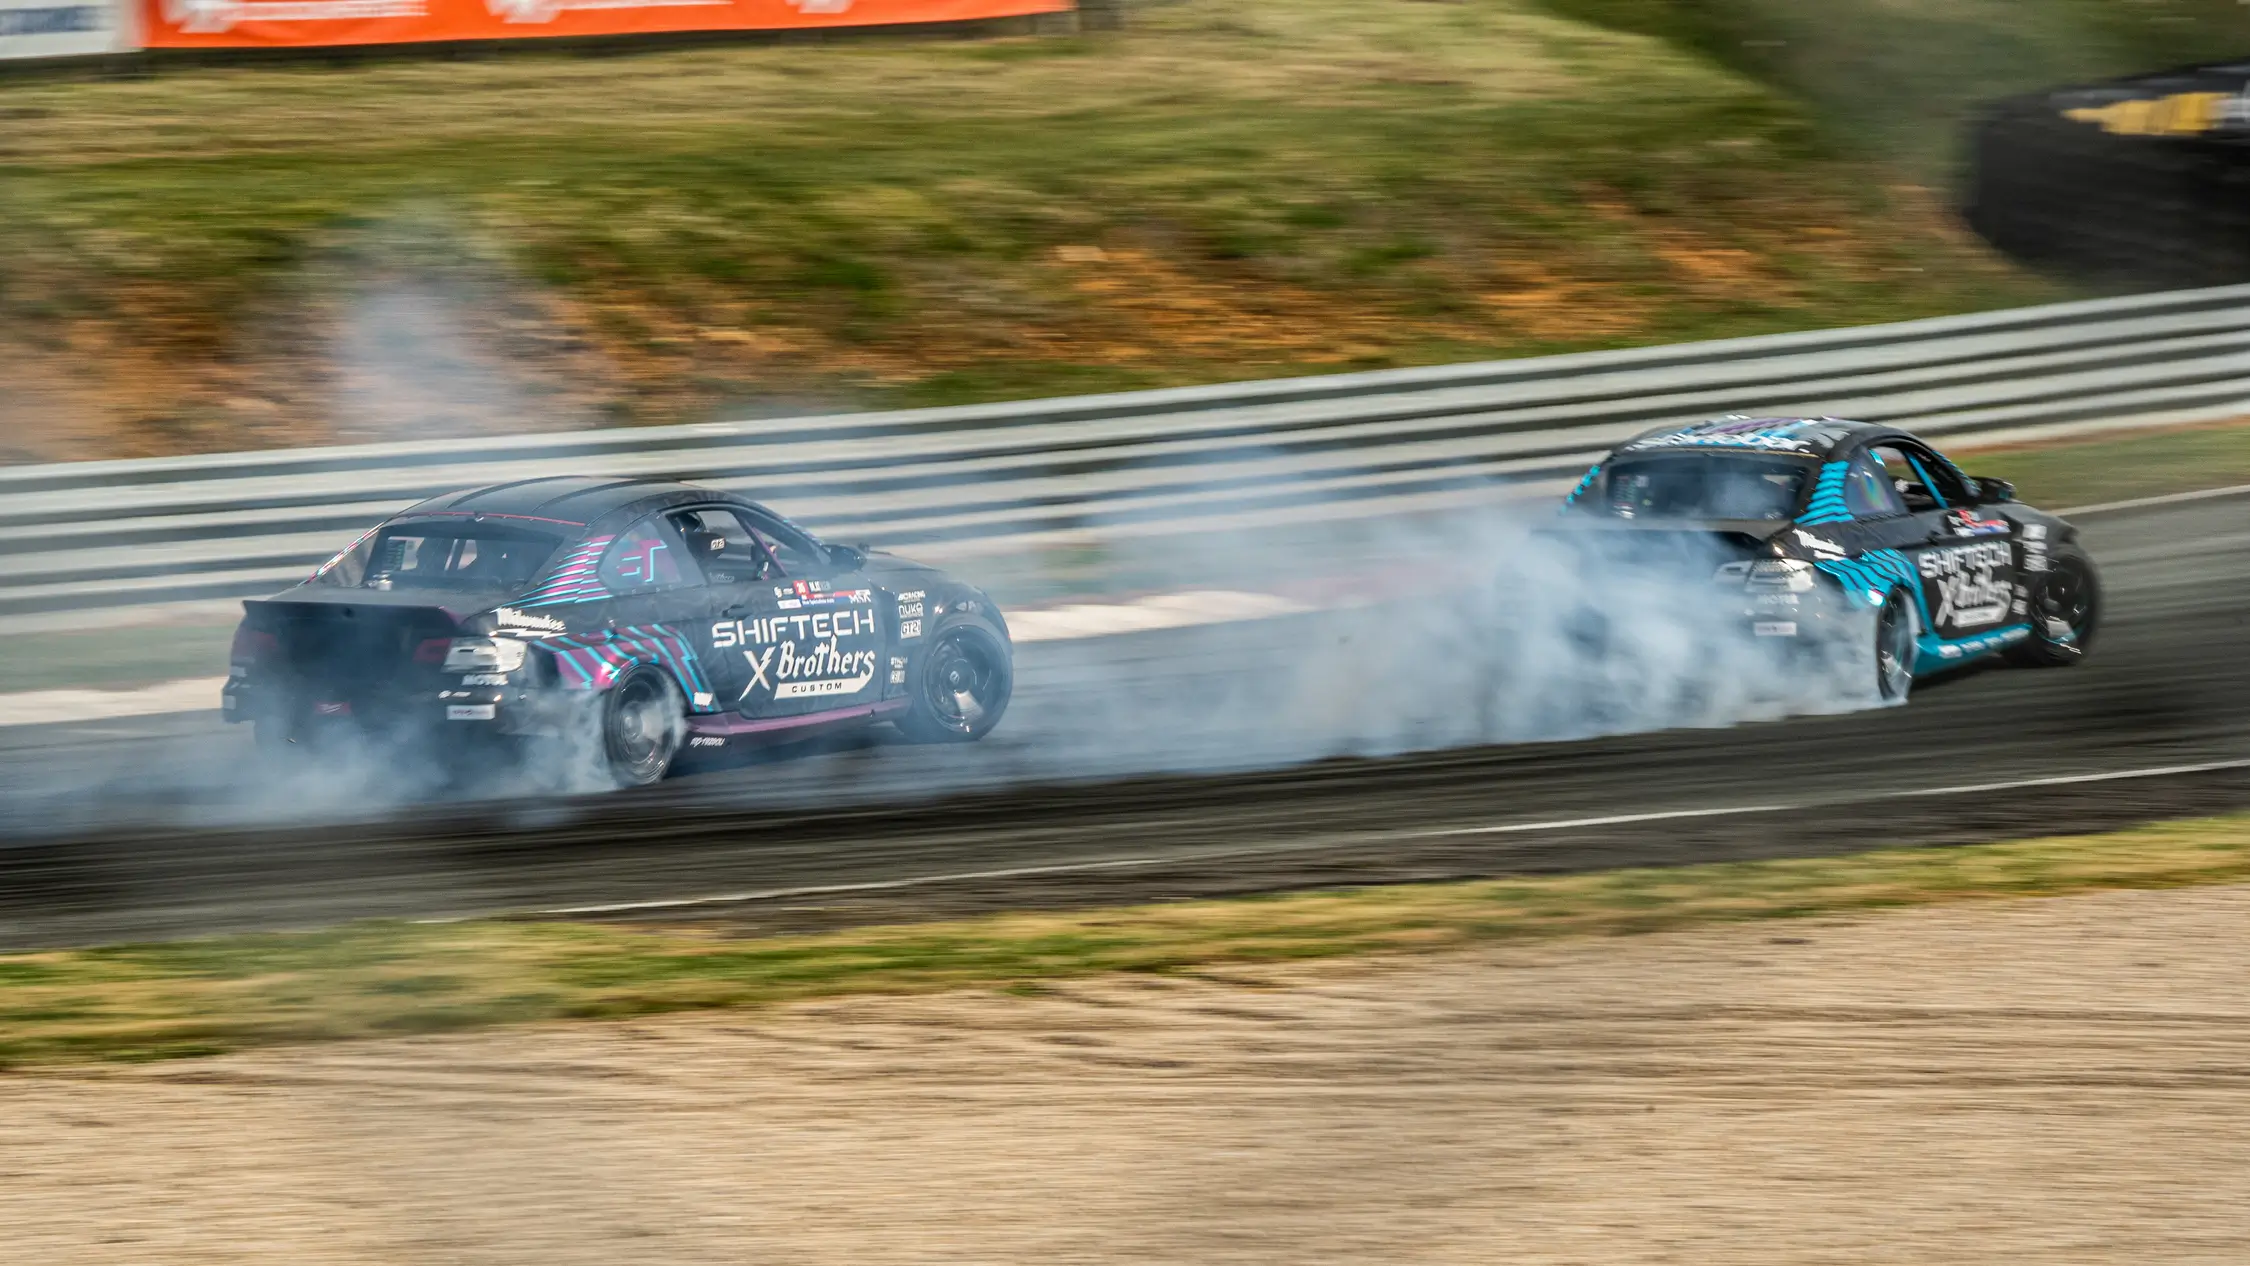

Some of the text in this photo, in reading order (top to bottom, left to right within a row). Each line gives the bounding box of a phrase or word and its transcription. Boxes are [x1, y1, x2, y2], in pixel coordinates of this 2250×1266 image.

[1918, 541, 2013, 578] SHIFTECH
[711, 609, 875, 648] SHIFTECH
[738, 634, 876, 701] X Brothers
[791, 681, 843, 694] CUSTOM
